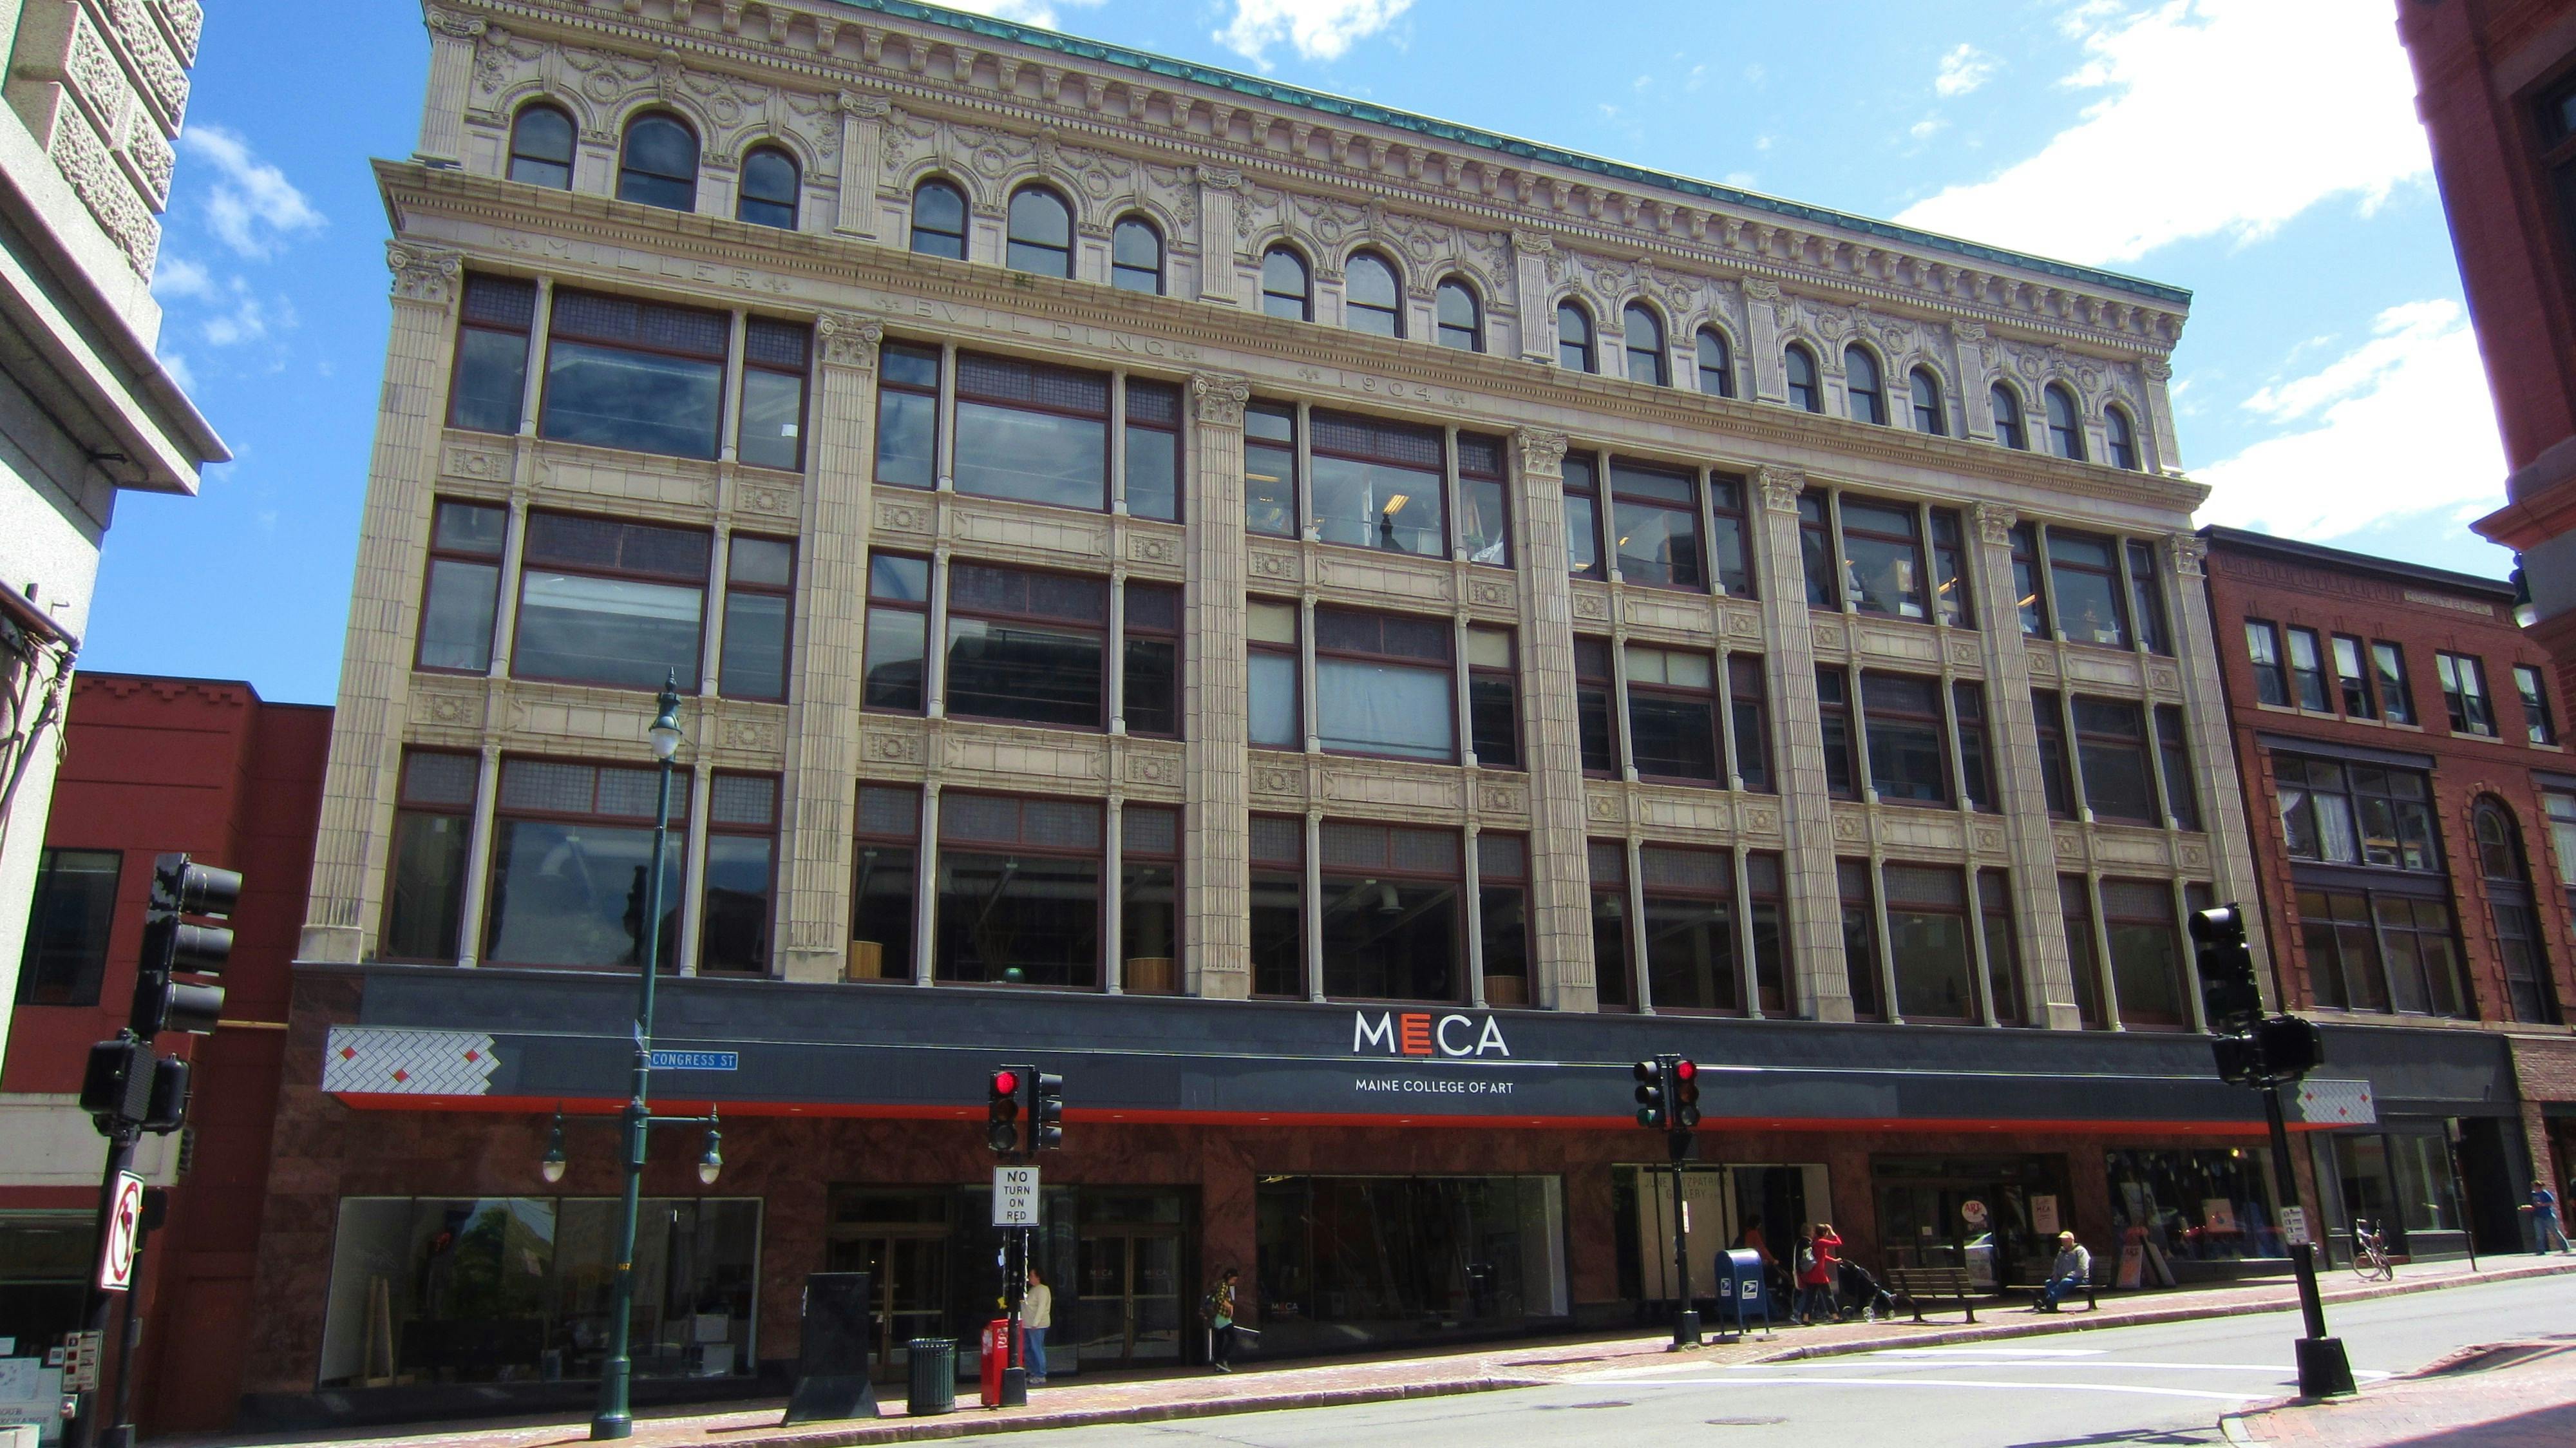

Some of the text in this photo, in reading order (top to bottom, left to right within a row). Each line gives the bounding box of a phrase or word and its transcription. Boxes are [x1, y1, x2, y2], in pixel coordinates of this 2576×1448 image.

[542, 238, 752, 289] MILLER
[913, 298, 1165, 357] BVILDING
[1338, 371, 1432, 402] 1904
[1353, 1009, 1510, 1056] MECA
[652, 1053, 735, 1067] CONGRESS ST
[1356, 1078, 1513, 1094] MAINE COLLEGE OF ART
[1007, 1171, 1028, 1183] NO
[1004, 1186, 1030, 1195] TURN
[1666, 1188, 1706, 1199] GLERY
[1009, 1198, 1025, 1208] ON
[1007, 1210, 1027, 1221] RED
